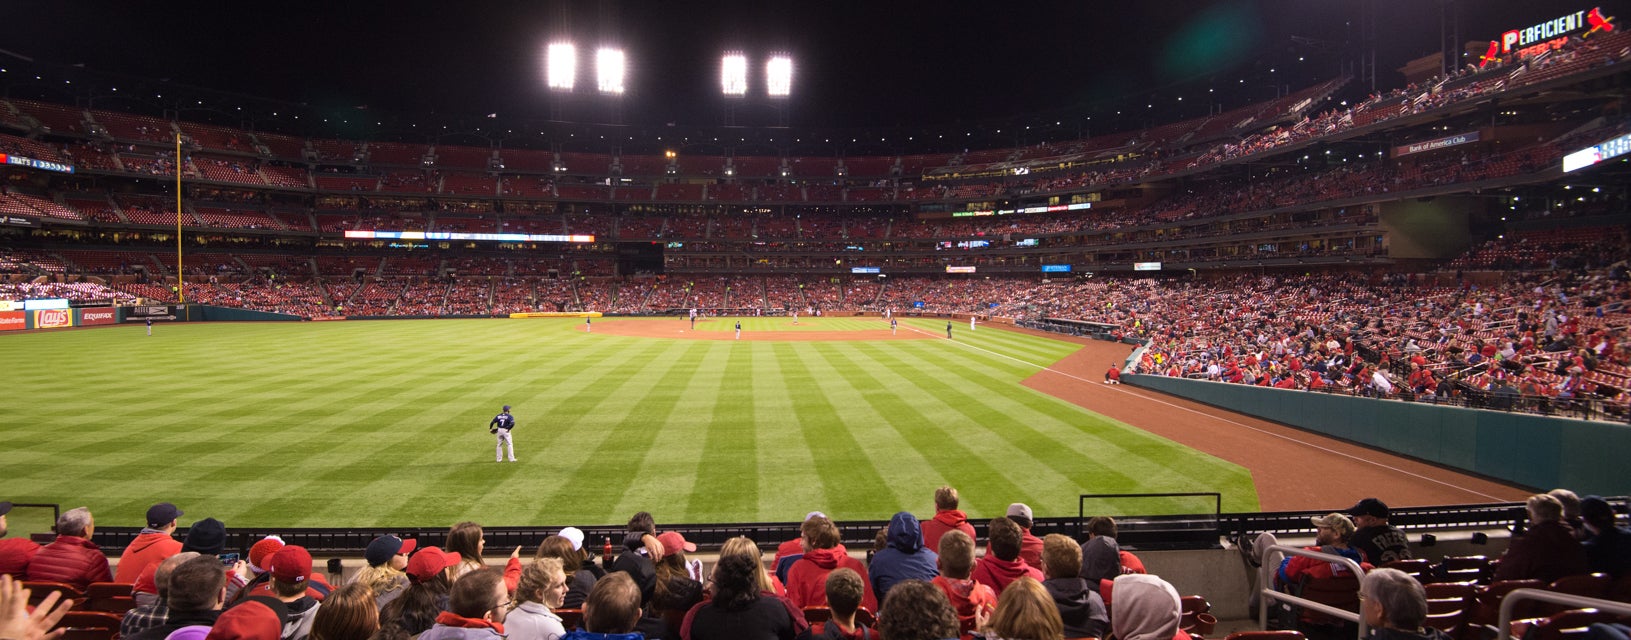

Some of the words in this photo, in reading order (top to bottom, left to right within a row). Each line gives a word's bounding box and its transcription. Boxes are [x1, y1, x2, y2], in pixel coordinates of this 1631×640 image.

[1502, 11, 1584, 54] PERFICIENT
[1409, 145, 1421, 153] Bank
[1430, 139, 1452, 149] America
[1453, 136, 1466, 144] Club
[84, 312, 113, 321] EQUIFAX
[499, 419, 505, 427] 7
